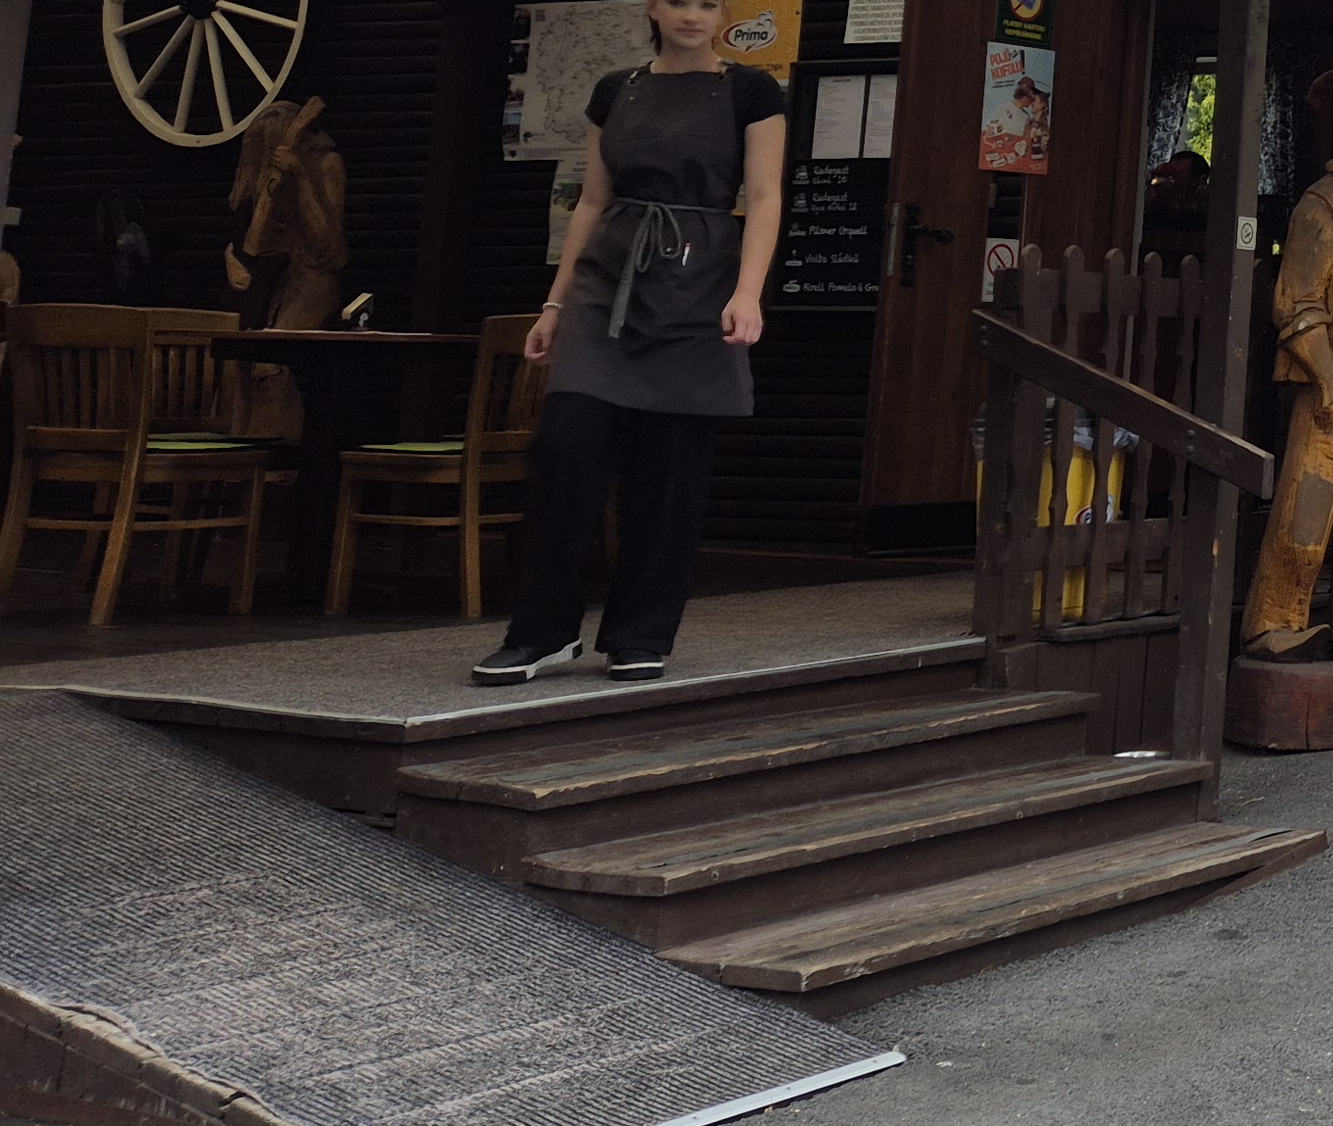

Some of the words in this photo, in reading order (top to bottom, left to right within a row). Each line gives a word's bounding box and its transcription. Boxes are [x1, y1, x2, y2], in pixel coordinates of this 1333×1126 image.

[734, 28, 768, 42] Prima
[813, 165, 850, 178] Radegast
[837, 175, 848, 184] 10
[812, 191, 848, 205] Radegast
[848, 202, 858, 211] 12
[838, 225, 868, 240] Urquell
[828, 282, 857, 292] Pomelo
